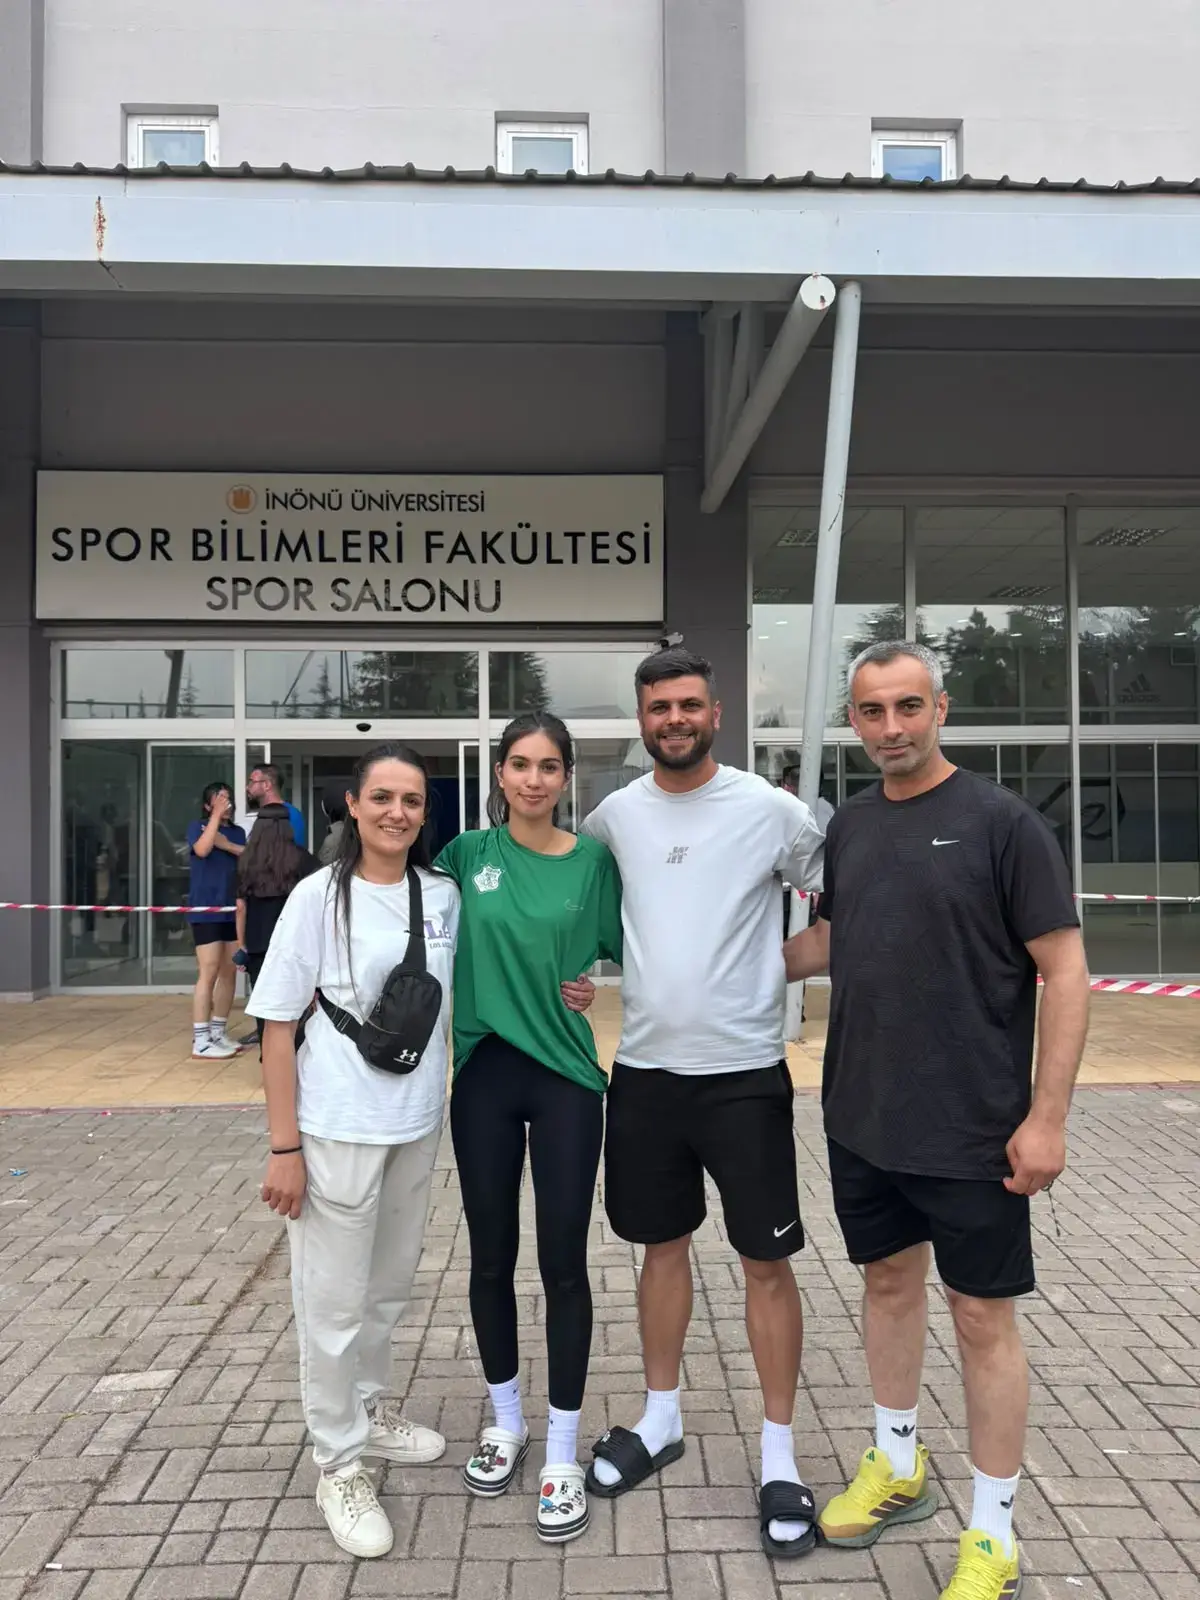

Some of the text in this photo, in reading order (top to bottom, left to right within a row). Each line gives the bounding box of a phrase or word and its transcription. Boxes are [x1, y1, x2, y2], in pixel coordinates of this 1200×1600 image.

[265, 487, 485, 513] İNÖNÜ ÜNİVERSİTESİ
[51, 518, 651, 567] SPOR BİLİMLERİ FAKÜLTESİ
[206, 575, 502, 614] SPOR SALONU
